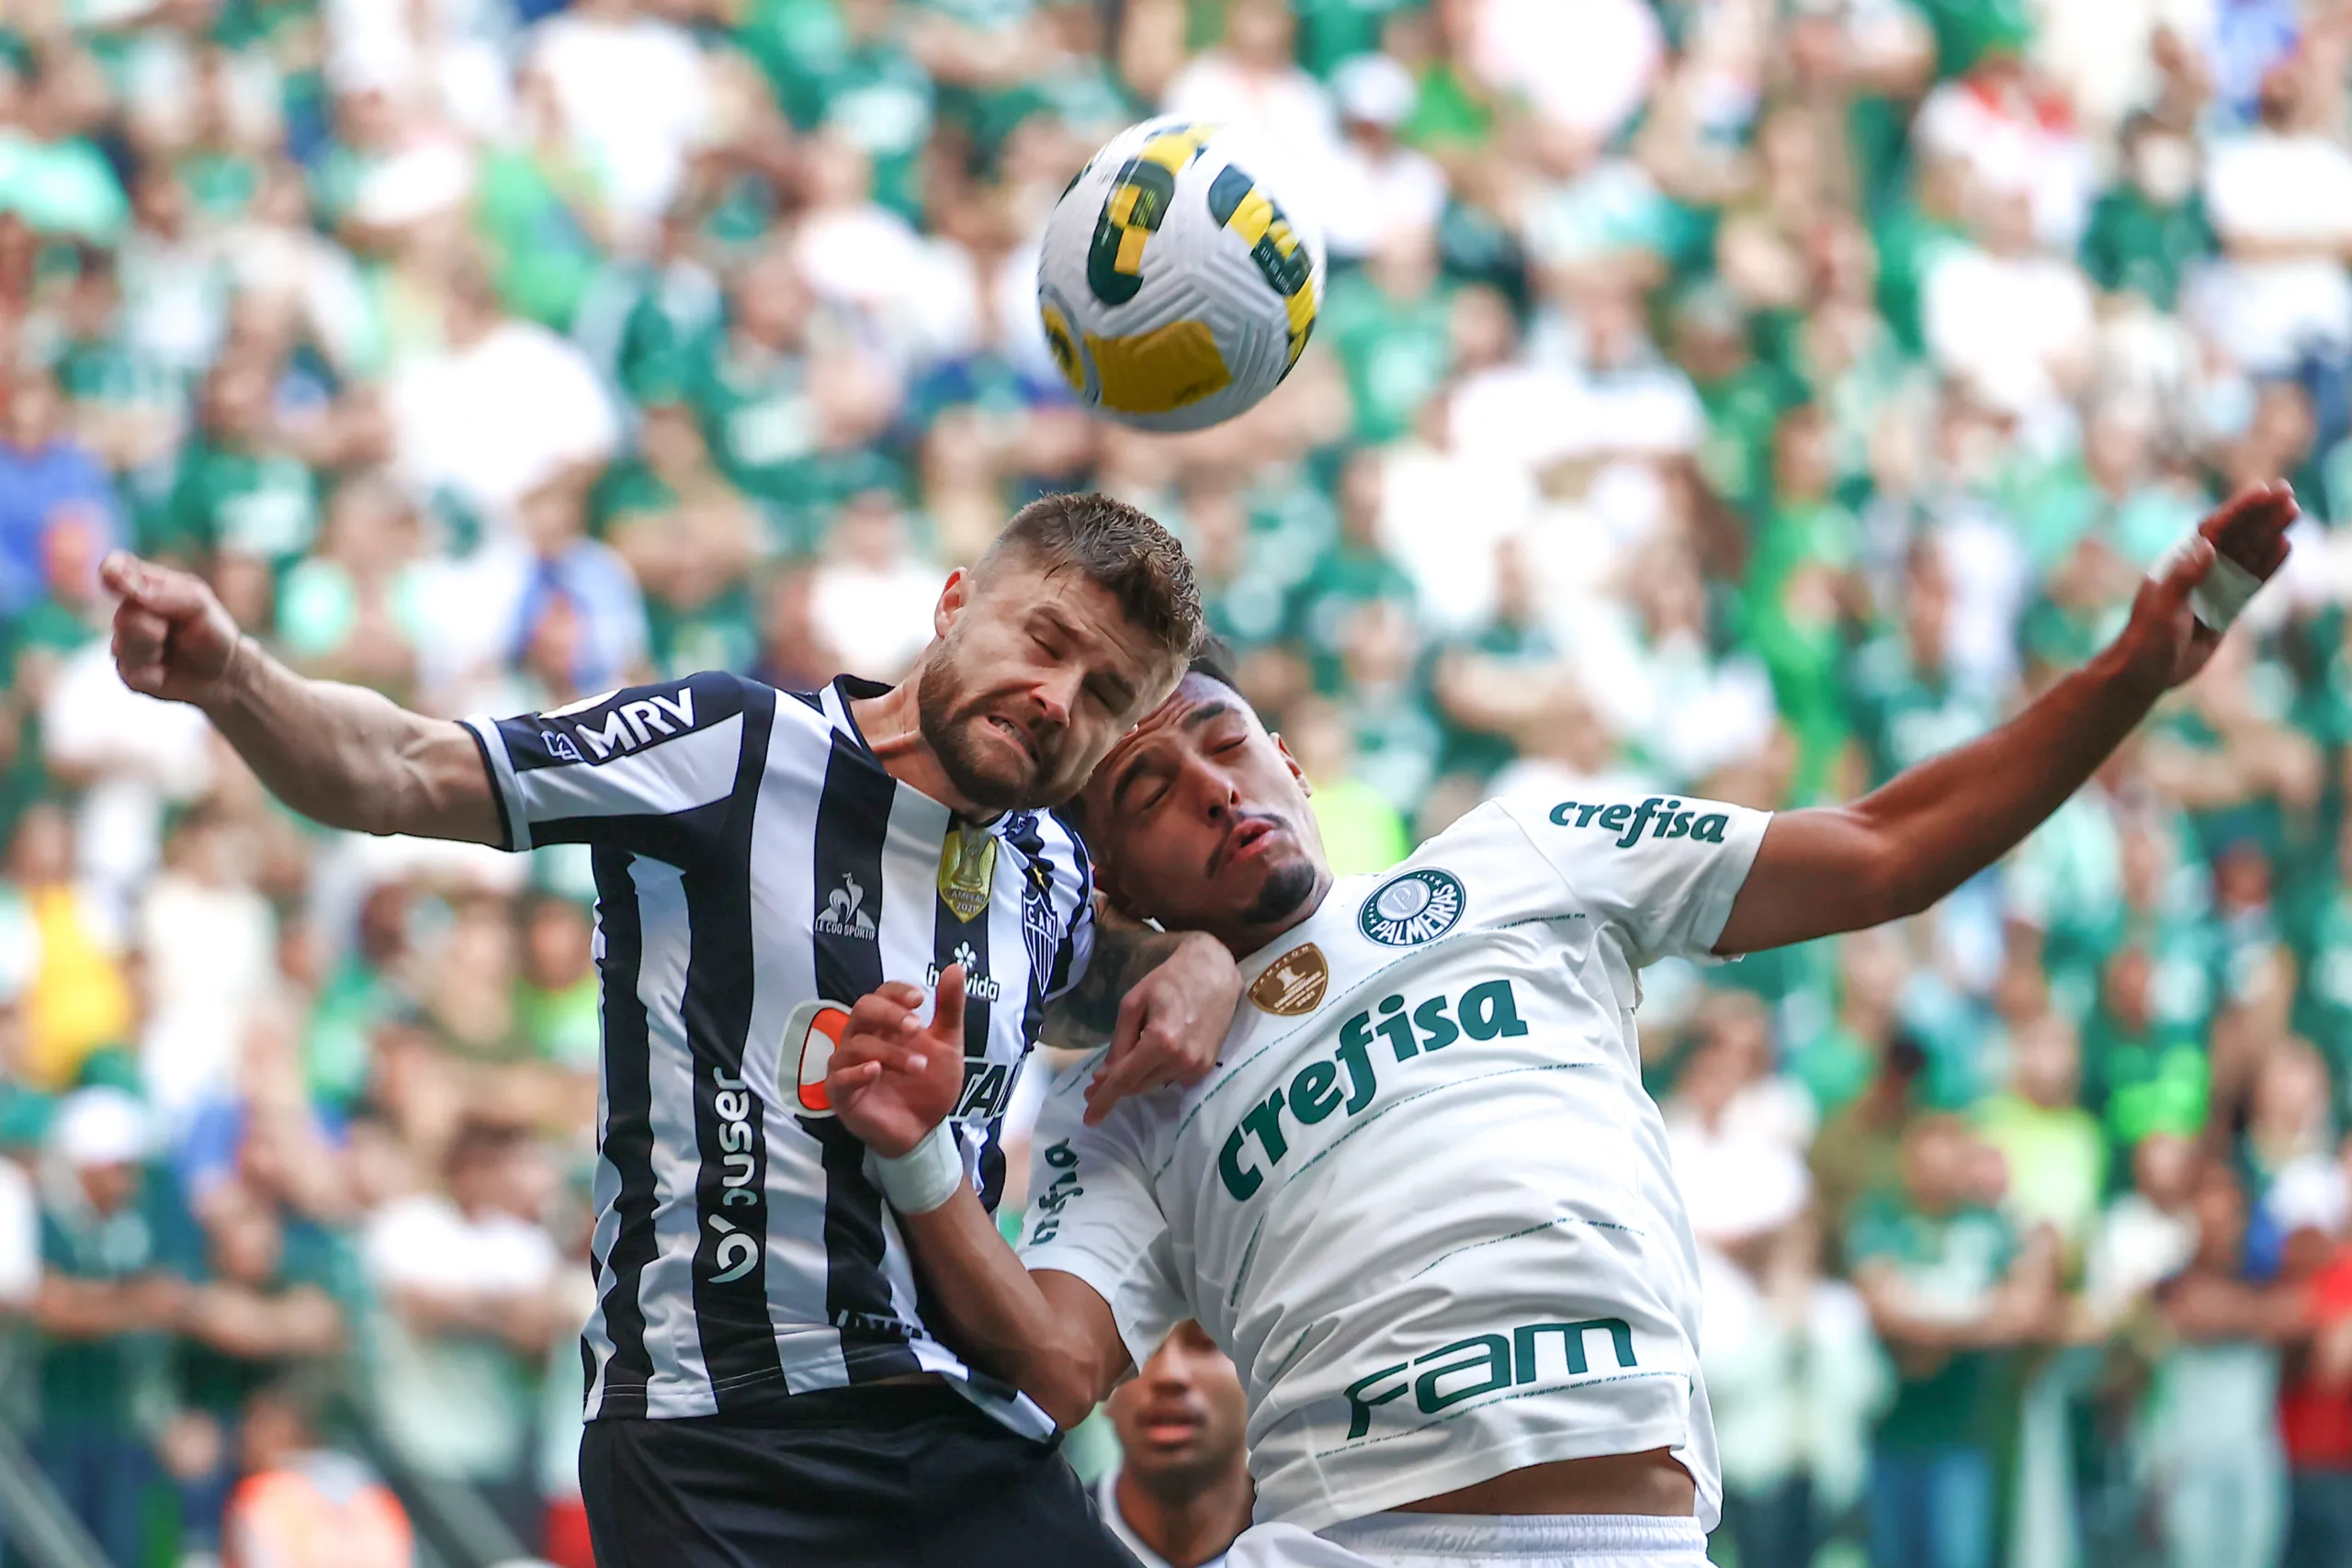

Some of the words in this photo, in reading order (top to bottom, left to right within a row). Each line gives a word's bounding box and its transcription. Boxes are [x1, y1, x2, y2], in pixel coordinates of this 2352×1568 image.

[575, 687, 693, 761] MRV
[1549, 798, 1729, 849] crefisa
[1369, 884, 1458, 945] PALMEIRAS
[928, 964, 999, 1001] hvida
[1218, 979, 1529, 1202] crefisa
